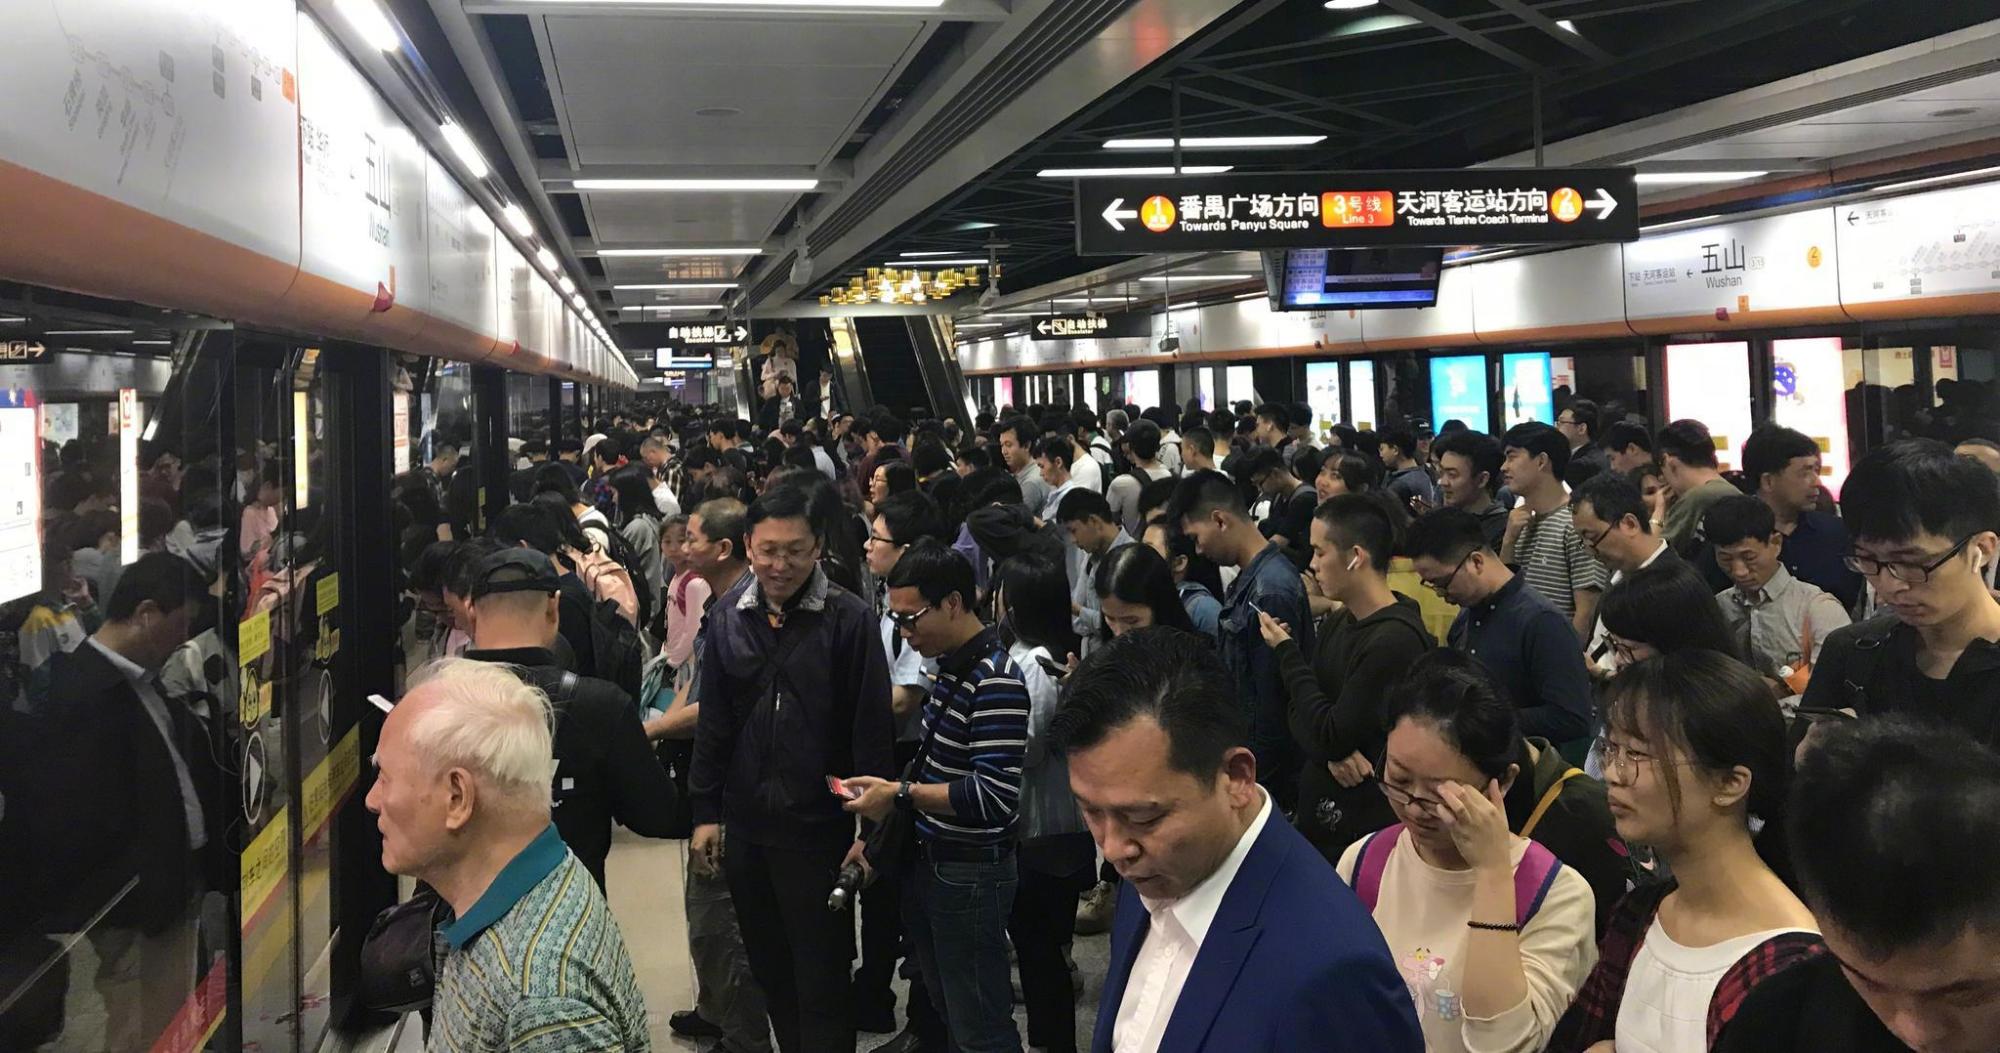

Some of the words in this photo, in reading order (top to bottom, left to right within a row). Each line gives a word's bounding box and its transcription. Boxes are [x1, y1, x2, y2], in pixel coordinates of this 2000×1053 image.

[364, 131, 391, 219] 五山
[1179, 193, 1320, 219] 番禺广场方向
[1333, 195, 1382, 214] 3号线
[1397, 188, 1548, 214] 天河客运站方向
[1180, 221, 1226, 232] Towards
[1231, 220, 1266, 232] Panyu
[1269, 219, 1309, 231] Square
[1342, 214, 1364, 224] Line
[1368, 214, 1374, 224] 3
[1407, 215, 1445, 226] Towards
[1447, 214, 1477, 225] Tianhe
[1478, 214, 1508, 225] Coach
[1511, 213, 1548, 224] Terminal
[1701, 238, 1746, 273] 五山
[1705, 276, 1743, 289] Wushan
